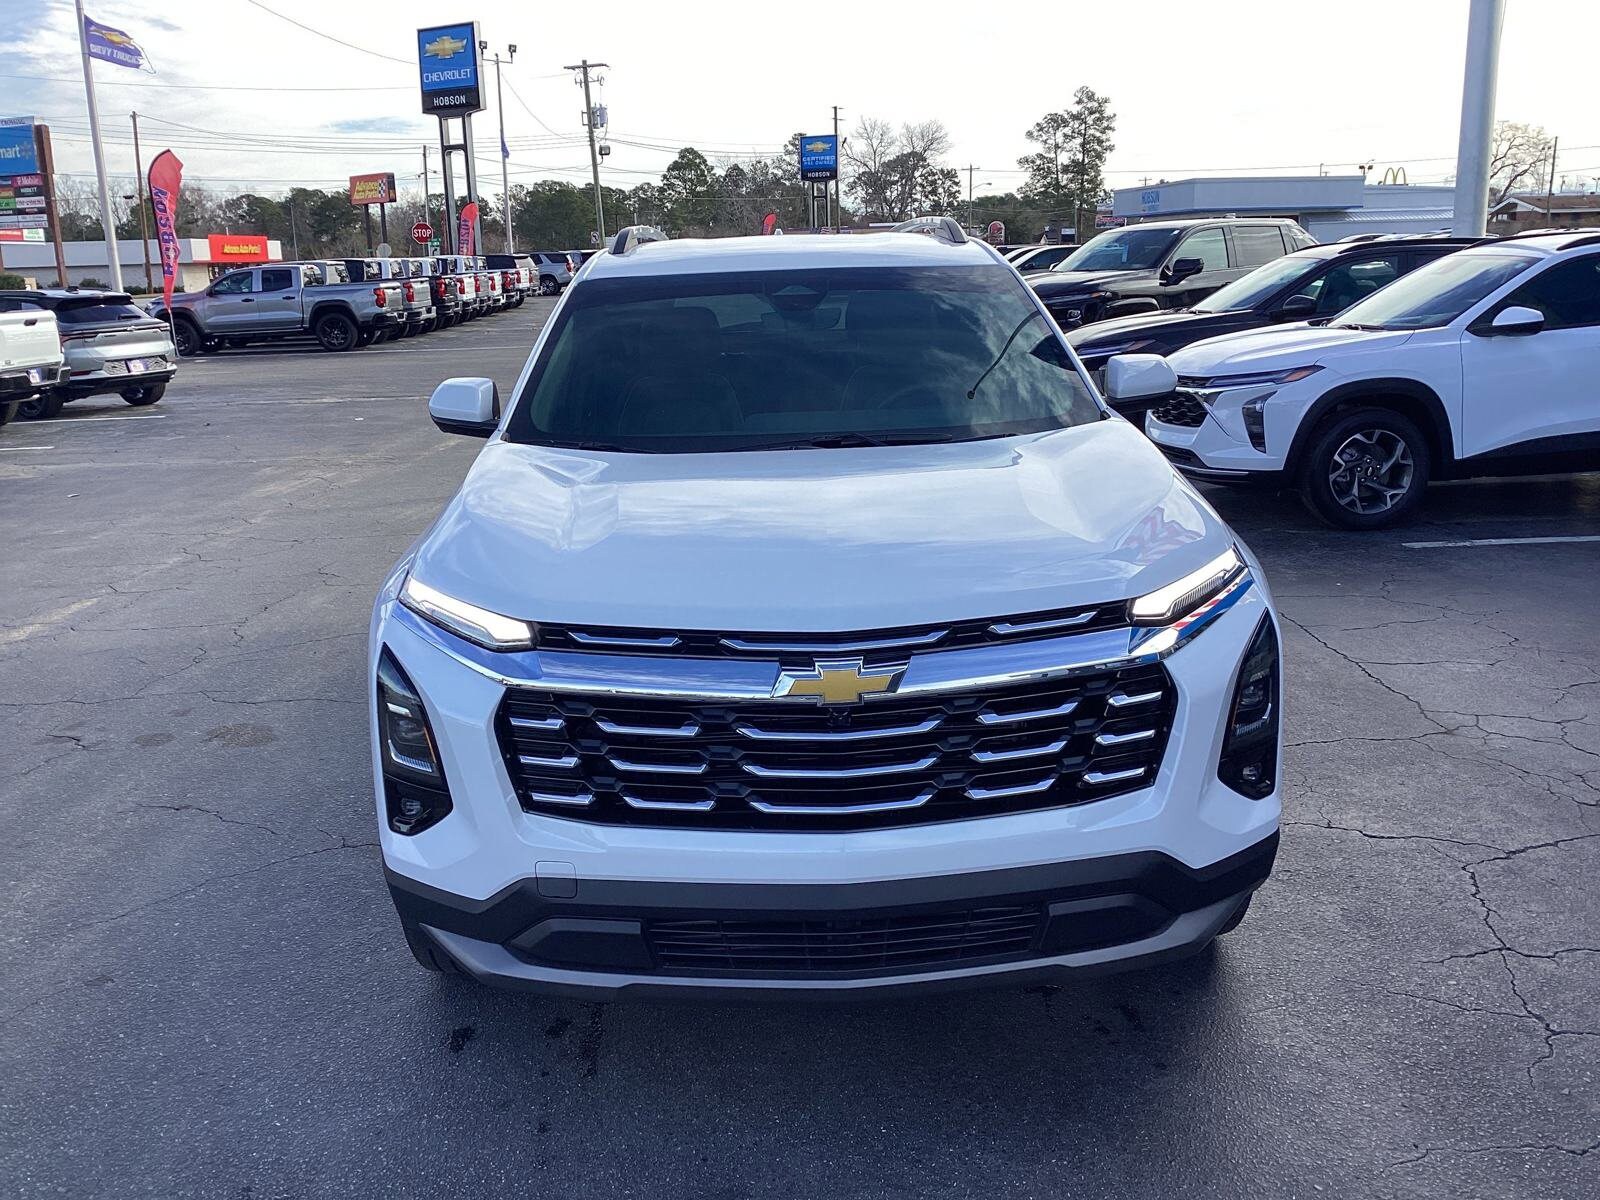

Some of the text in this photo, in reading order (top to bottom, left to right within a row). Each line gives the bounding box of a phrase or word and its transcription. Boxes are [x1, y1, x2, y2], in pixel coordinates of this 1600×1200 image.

[89, 43, 112, 56] CHEVY
[423, 68, 471, 82] CHEVROLET
[433, 95, 466, 106] HOBSON
[152, 186, 174, 277] HOBSON
[413, 228, 432, 238] STOP
